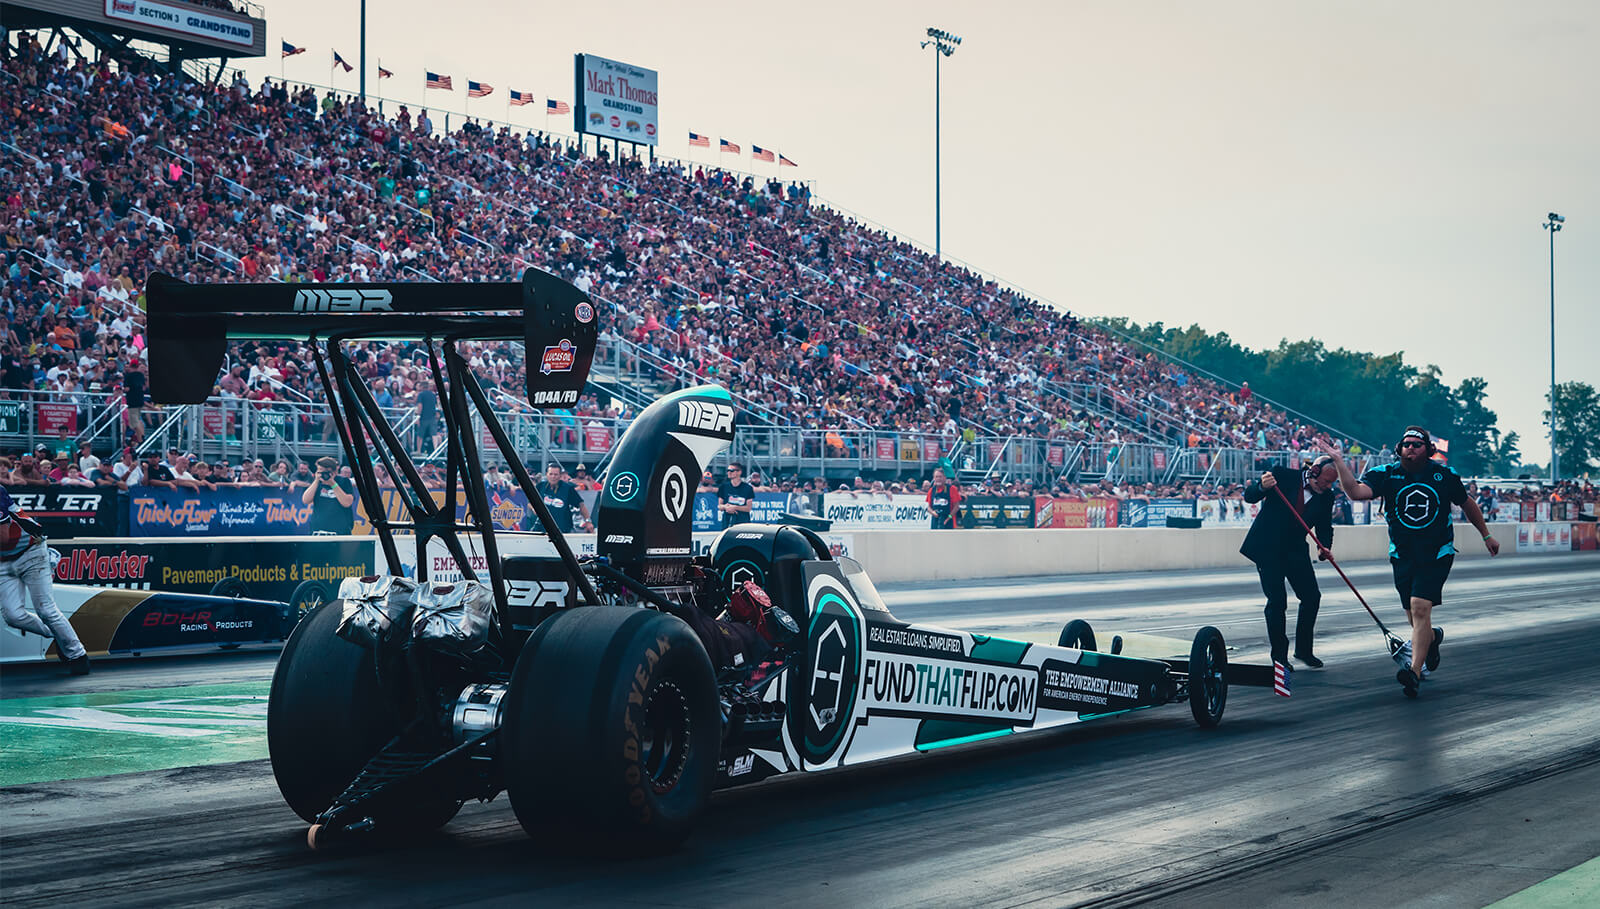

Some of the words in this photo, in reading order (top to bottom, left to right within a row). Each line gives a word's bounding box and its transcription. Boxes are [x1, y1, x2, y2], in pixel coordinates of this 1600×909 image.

[139, 6, 173, 22] SECTION
[174, 14, 180, 23] 3
[186, 16, 251, 39] GRANDSTAND
[587, 70, 615, 96] Mark
[617, 77, 657, 106] Thomas
[603, 99, 643, 114] GRANDSTAND
[545, 352, 563, 362] LUCAS
[563, 352, 571, 362] OIL
[534, 390, 578, 404] 104A/FD
[492, 509, 522, 520] SUNOCO
[750, 510, 766, 521] OWN
[828, 504, 864, 521] COMETIC
[895, 506, 929, 522] COMETIC
[581, 543, 594, 553] THE
[52, 549, 149, 580] alMaster
[163, 566, 227, 584] Pavement
[231, 565, 286, 583] Products
[290, 564, 299, 581] &
[303, 562, 367, 583] Equipment
[870, 627, 885, 643] REAL
[886, 629, 907, 646] ESTATE
[907, 631, 928, 650] LOANS,
[929, 635, 961, 653] SIMPLIFIED.
[862, 659, 1036, 714] FUNDTHATFLIP.COM
[1045, 669, 1060, 687] THE
[1060, 672, 1109, 695] EMPOWERMENT
[1109, 680, 1139, 699] ALLIANCE
[1043, 688, 1051, 697] FOR
[1051, 690, 1069, 700] AMERICAN
[733, 753, 755, 770] SLM
